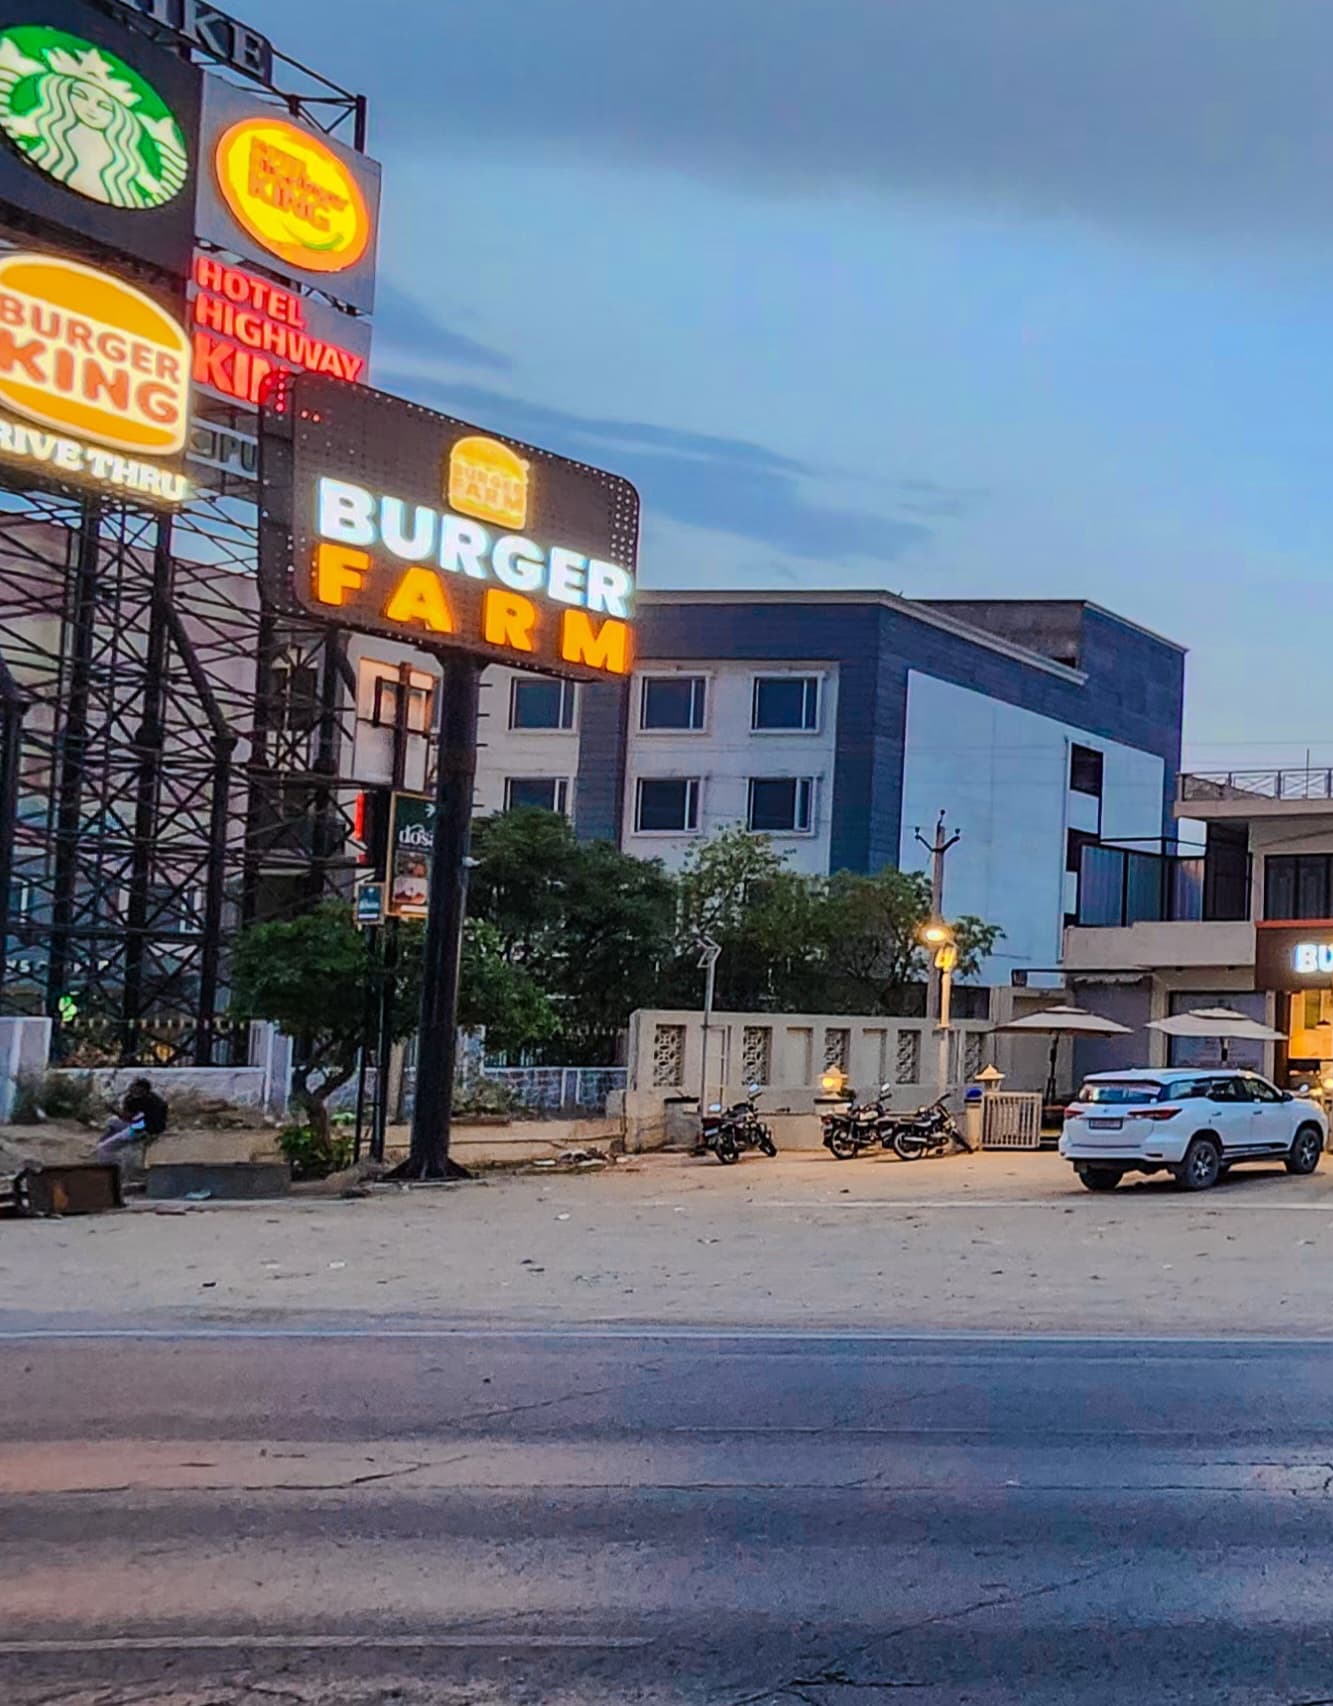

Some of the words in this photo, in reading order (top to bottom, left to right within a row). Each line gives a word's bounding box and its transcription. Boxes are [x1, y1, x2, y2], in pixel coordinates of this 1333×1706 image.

[194, 291, 364, 383] HIGHWAY
[195, 254, 306, 331] HOTEL
[0, 294, 181, 386] BURGER
[0, 326, 179, 425] KING
[192, 331, 282, 404] KIN
[0, 420, 84, 471] RIVE
[86, 445, 190, 500] THRU
[316, 476, 634, 620] BURGER
[314, 541, 634, 676] FARM
